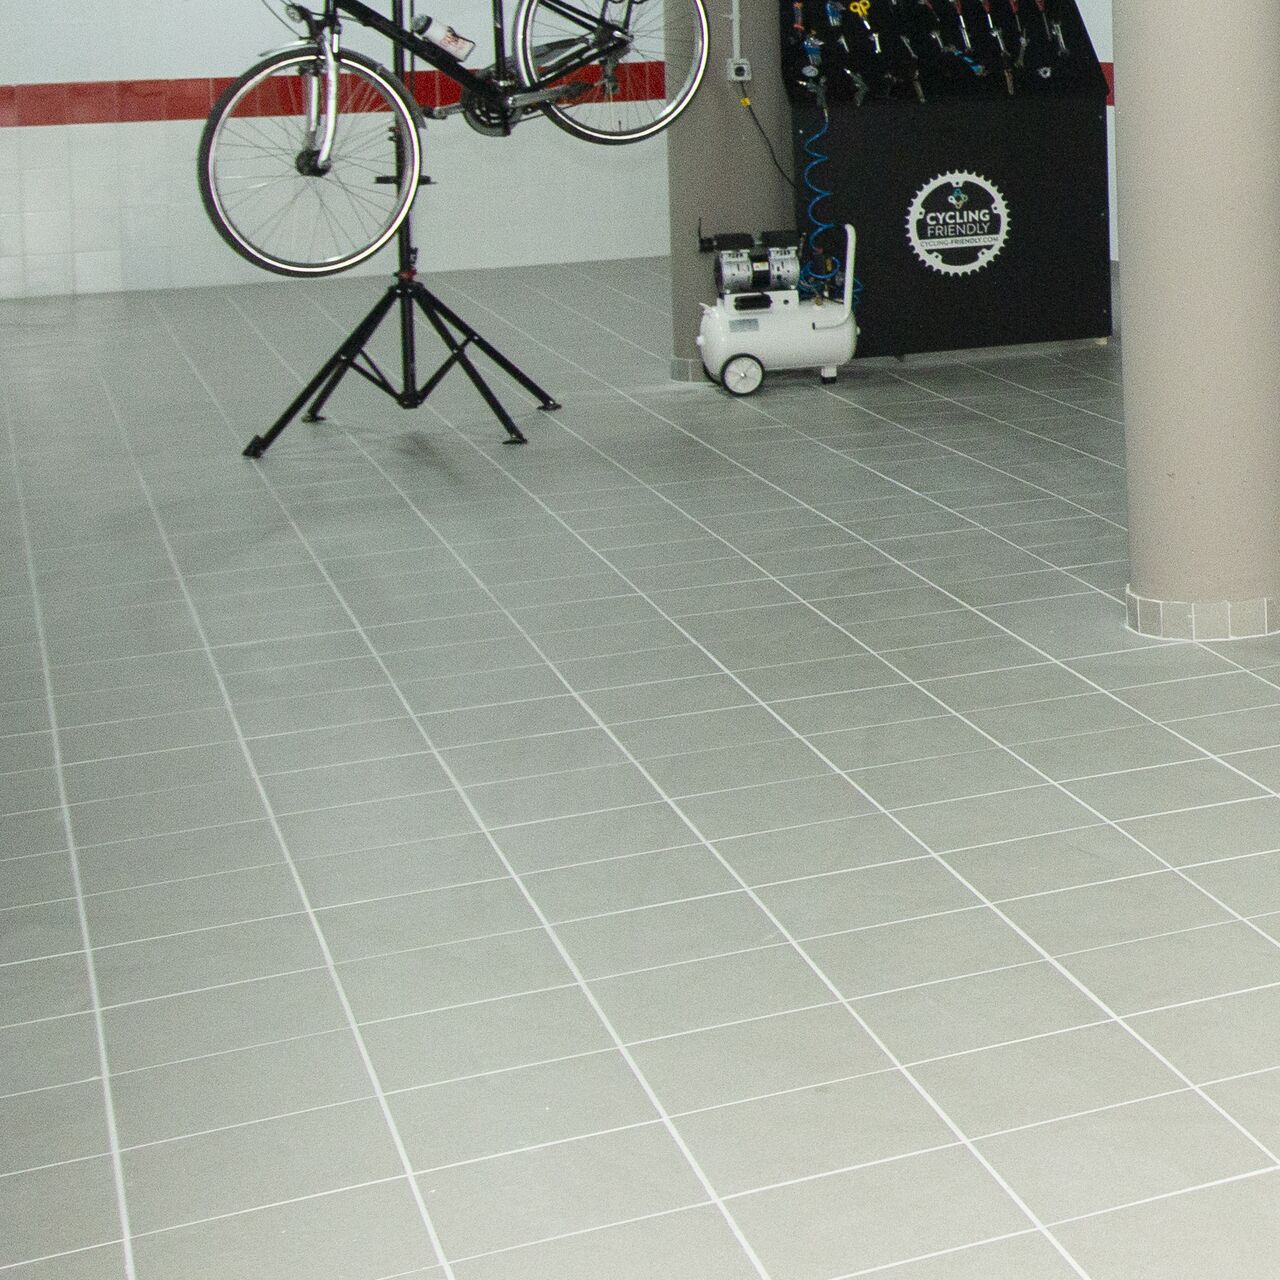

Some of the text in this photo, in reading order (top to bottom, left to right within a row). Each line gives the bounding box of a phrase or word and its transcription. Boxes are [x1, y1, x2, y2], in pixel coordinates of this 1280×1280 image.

[926, 209, 991, 225] CYCLING
[927, 222, 991, 237] FRIENDLY
[920, 236, 999, 248] CYCLING-FRIENDLY.COM
